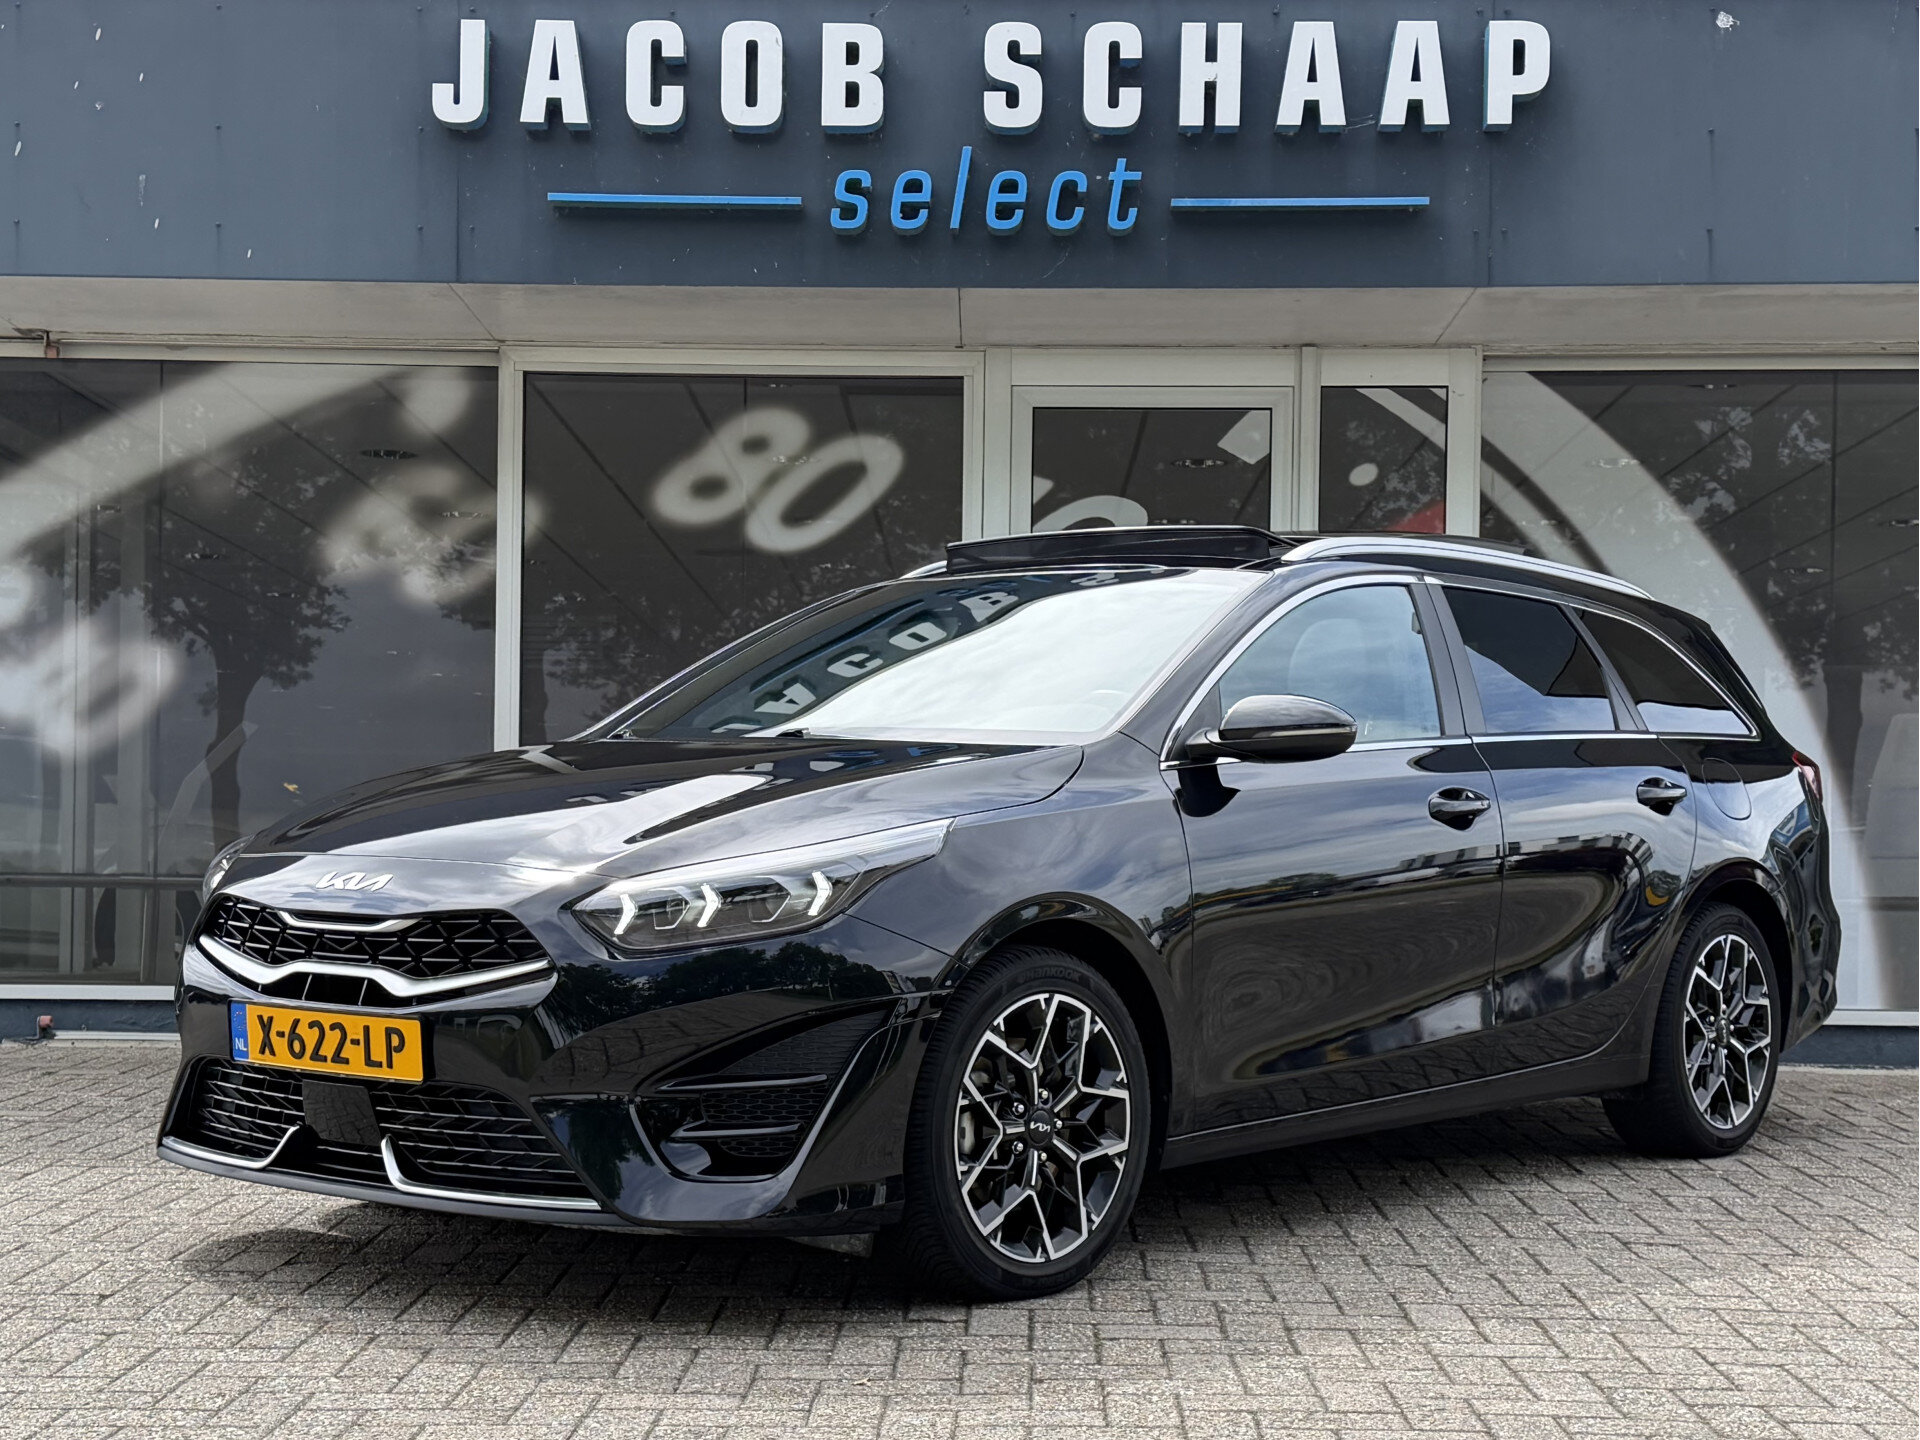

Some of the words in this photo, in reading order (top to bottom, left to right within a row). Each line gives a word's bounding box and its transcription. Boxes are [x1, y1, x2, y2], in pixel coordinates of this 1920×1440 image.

[432, 19, 889, 131] JACOB
[983, 20, 1551, 132] SCHAAP
[831, 147, 1143, 233] select
[653, 407, 905, 552] 80
[316, 871, 393, 892] KIA
[234, 1036, 248, 1052] NL
[256, 1014, 406, 1070] X-622-LP
